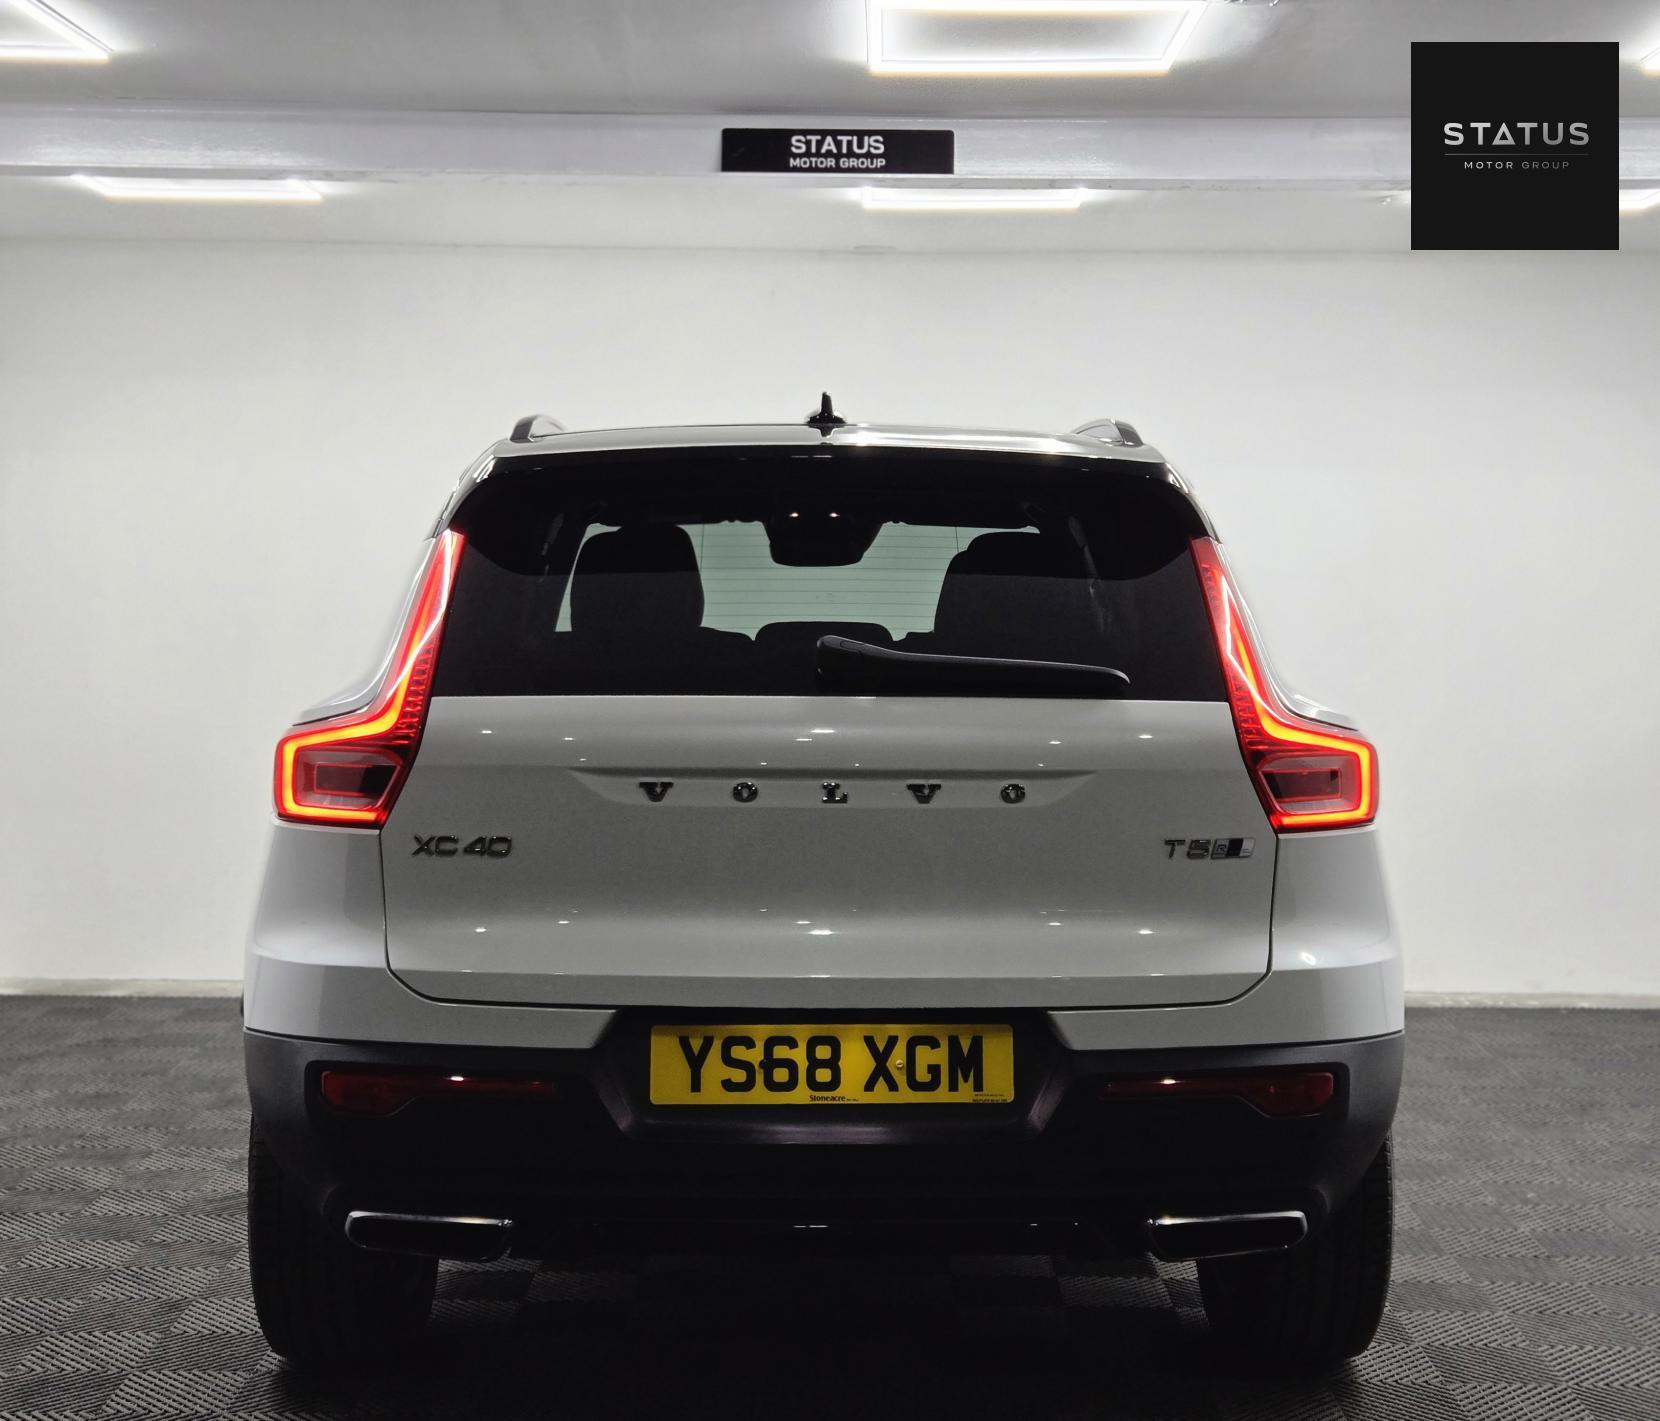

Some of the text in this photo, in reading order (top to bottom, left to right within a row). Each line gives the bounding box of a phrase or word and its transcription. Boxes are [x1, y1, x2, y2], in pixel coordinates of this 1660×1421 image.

[790, 135, 885, 154] STATUS
[789, 157, 886, 169] MOTOR GROUP
[638, 781, 1026, 804] VOLVO
[678, 1034, 984, 1093] YS68 XGM
[809, 1094, 846, 1102] Stoneacre
